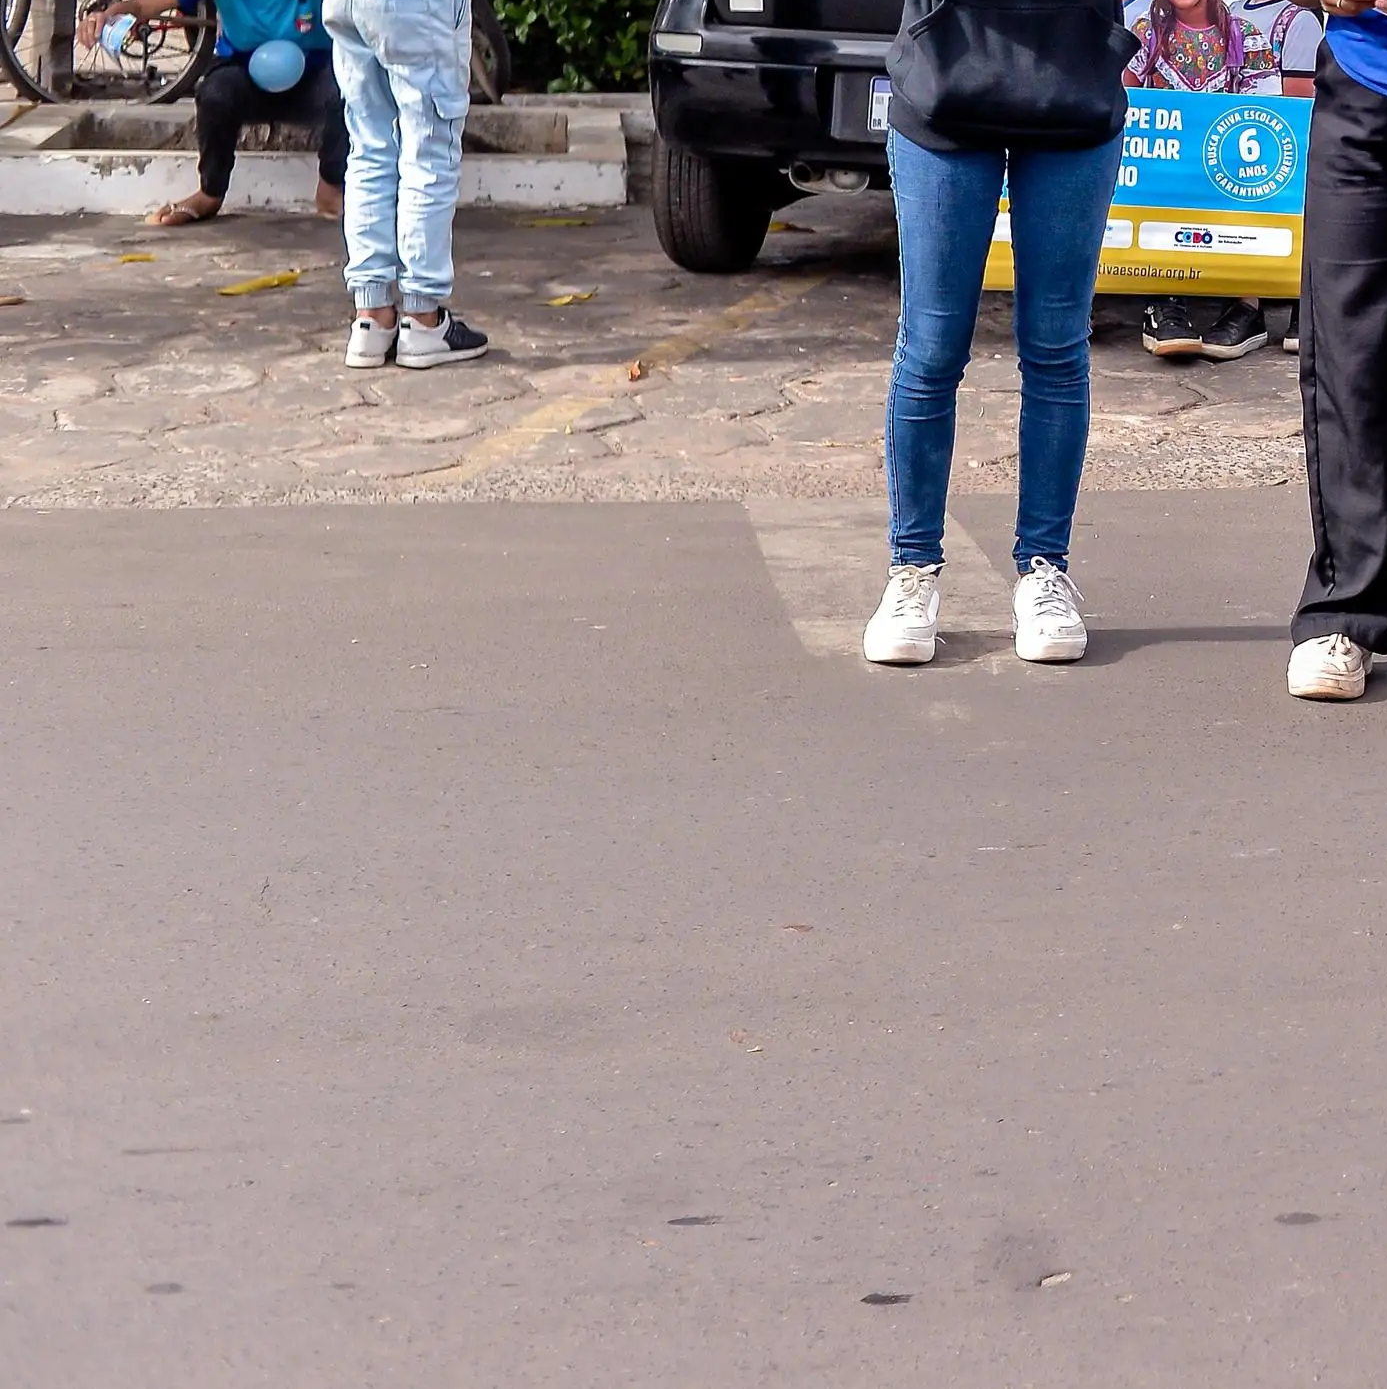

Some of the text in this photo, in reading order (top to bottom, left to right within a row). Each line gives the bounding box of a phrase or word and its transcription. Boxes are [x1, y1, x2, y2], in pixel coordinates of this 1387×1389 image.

[1155, 108, 1183, 131] DA
[1207, 110, 1284, 166] BUSCA ATIVA ESCOLAR
[1238, 127, 1261, 163] 6
[1215, 137, 1294, 197] GARANTINDO DIREITOS
[1238, 164, 1268, 179] ANOS
[1174, 230, 1213, 245] CODÓ
